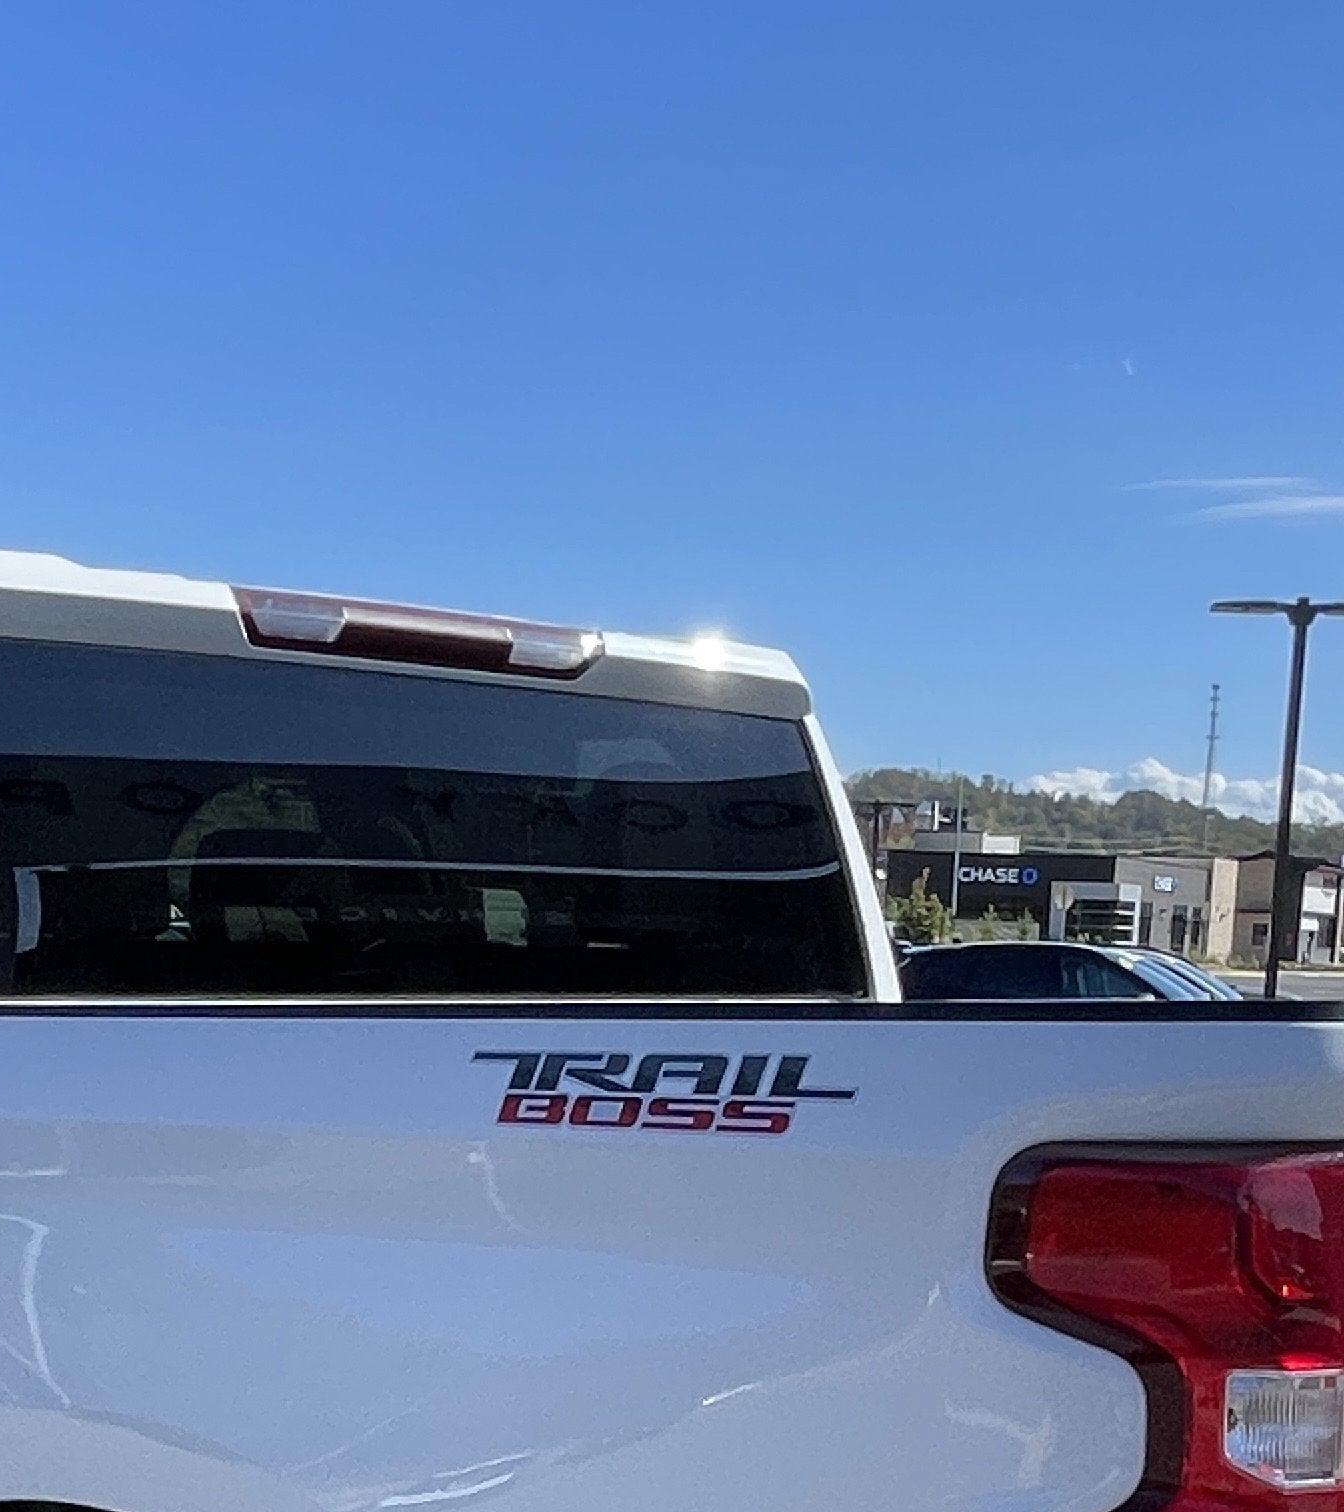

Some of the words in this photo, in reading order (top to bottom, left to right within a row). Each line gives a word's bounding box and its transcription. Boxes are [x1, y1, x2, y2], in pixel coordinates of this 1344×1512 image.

[958, 866, 1020, 884] CHASE
[472, 1051, 856, 1100] TRAIL
[497, 1094, 797, 1134] BOSS
